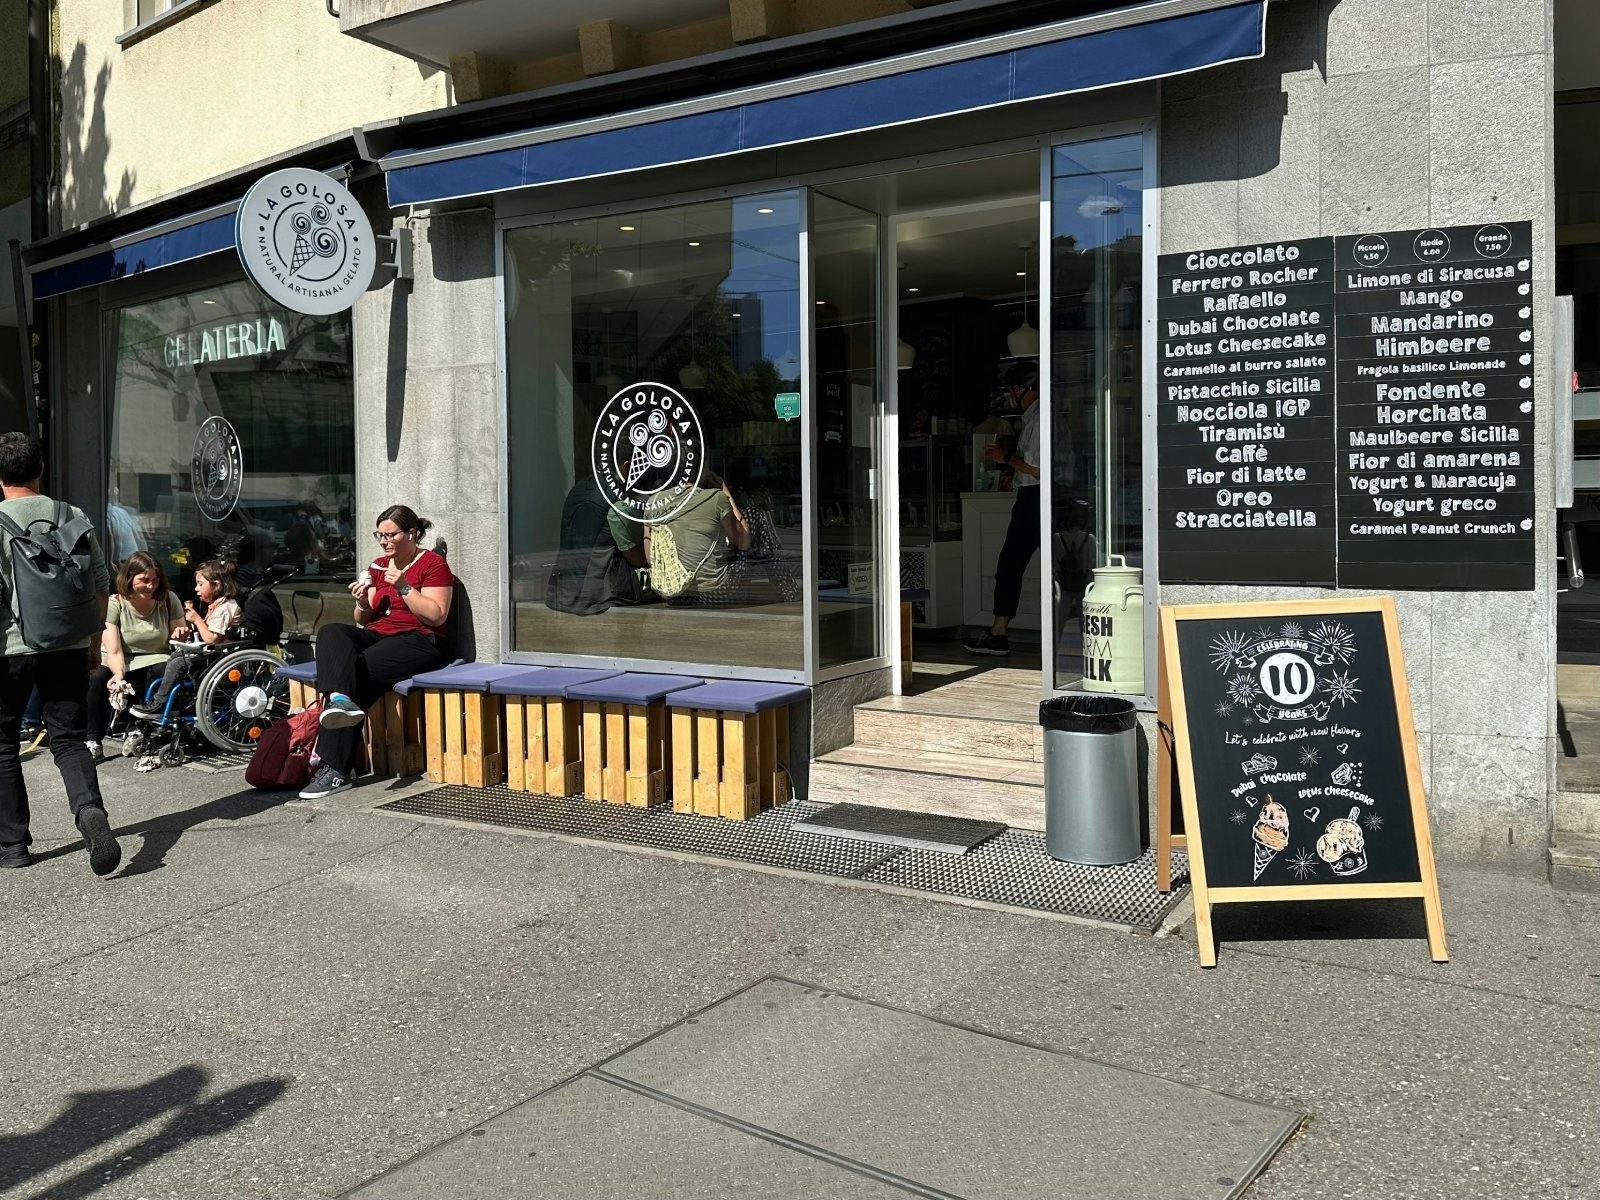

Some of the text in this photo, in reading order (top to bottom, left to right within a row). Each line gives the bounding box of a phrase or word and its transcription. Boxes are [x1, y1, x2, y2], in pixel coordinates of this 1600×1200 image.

[258, 183, 356, 230] LA GOLOSA
[1357, 244, 1385, 252] Piccolo
[1478, 234, 1508, 242] Grande
[258, 236, 361, 298] NATURAL ARTISANAL GELATO
[1186, 245, 1300, 271] Cioccolato
[1172, 266, 1319, 294] Ferrero Rocher
[1347, 265, 1515, 289] Limone di Siracusa
[1203, 291, 1287, 313] Raffaello
[1400, 289, 1464, 309] Mango
[1167, 310, 1321, 337] Dubai Chocolate
[1371, 311, 1494, 333] Mandarino
[164, 317, 286, 368] GELATERIA
[1165, 332, 1327, 358] Lotus Cheesecake
[1375, 336, 1491, 357] Himbeere
[1163, 356, 1327, 377] Caramello al burro salato
[1357, 359, 1506, 377] Fragola basilico Limonade
[1168, 377, 1321, 401] Pistacchio Sicilia
[1376, 381, 1486, 401] Fondente
[601, 391, 691, 438] LA GOLOSA
[1177, 398, 1311, 422] Nocciola IGP
[1377, 403, 1487, 424] Horchata
[1199, 423, 1285, 442] Tiramisù
[1349, 425, 1520, 446] Maulbeere Sicilia
[1215, 444, 1268, 463] Caffè
[1349, 451, 1521, 470] Fior di amarena
[600, 452, 695, 511] NATURAL ARTISANAL GELATO
[1187, 465, 1307, 485] Fior di latte
[1349, 472, 1517, 494] Yogurt & Maracuja
[1216, 489, 1273, 507] Oreo
[1373, 497, 1497, 517] Yogurt greco
[1175, 509, 1317, 528] Stracciatella
[1349, 522, 1516, 535] Caramel Peanut Crunch
[1084, 614, 1113, 637] ESH
[1083, 636, 1113, 658] RM
[1256, 640, 1309, 653] CELEBRATING
[1084, 656, 1113, 682] ILK
[1269, 662, 1309, 696] 10
[1225, 723, 1362, 746] Let's celebrate with new flavors
